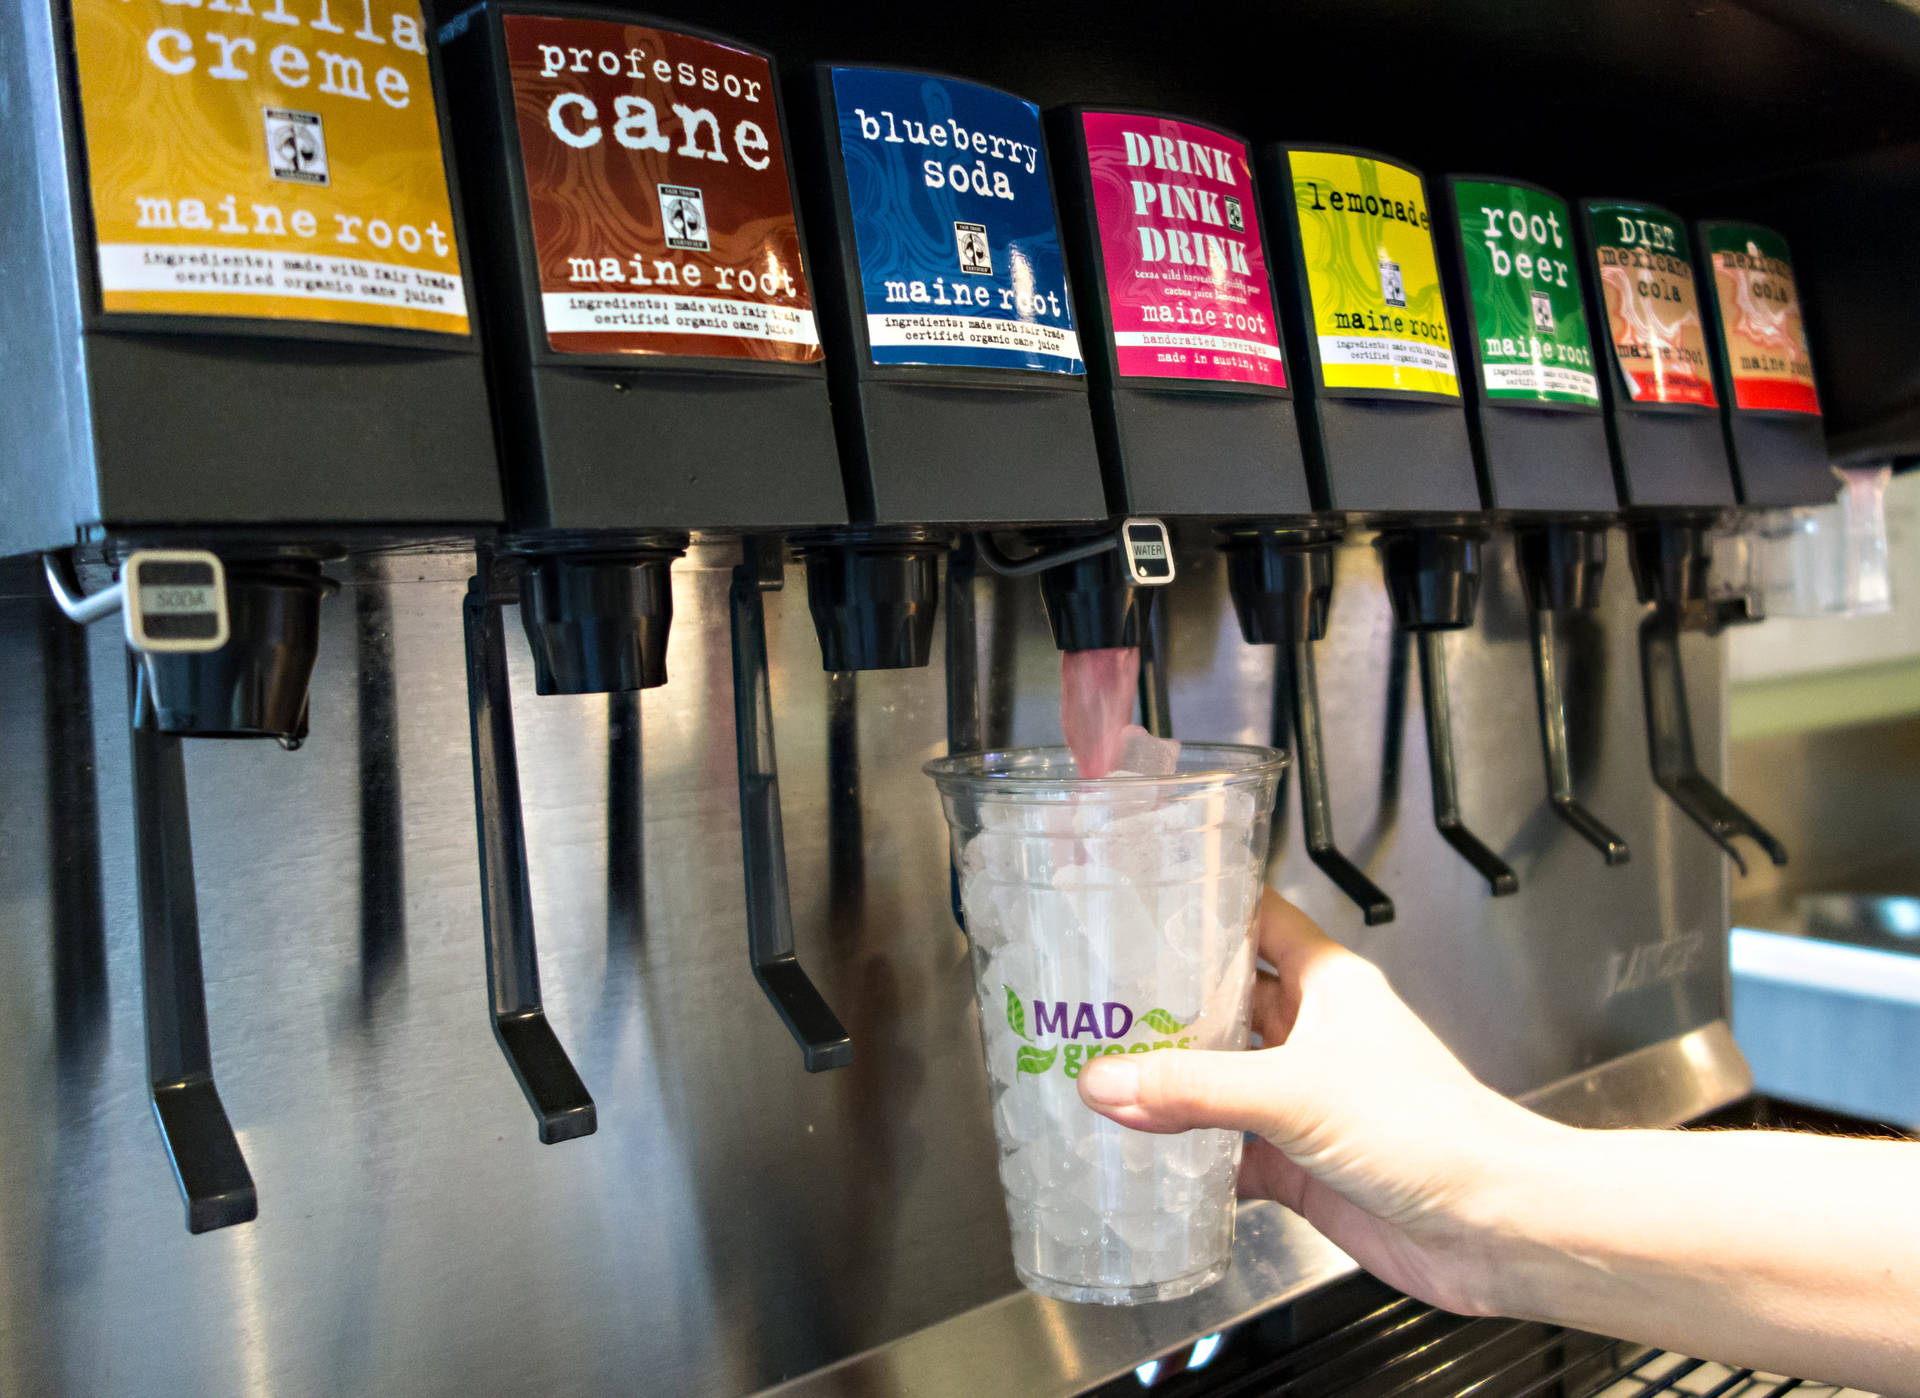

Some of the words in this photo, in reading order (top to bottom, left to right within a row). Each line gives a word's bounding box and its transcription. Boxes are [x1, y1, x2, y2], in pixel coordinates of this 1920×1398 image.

[147, 28, 410, 109] creme
[538, 43, 761, 103] professor
[547, 92, 771, 171] cane
[855, 108, 1037, 174] blueberry
[1122, 131, 1236, 186] DRINK
[923, 159, 1015, 201] soda
[1130, 180, 1224, 227] PINK
[1307, 182, 1429, 231] lemonade
[136, 194, 318, 238] maine
[334, 212, 449, 257] root
[1481, 206, 1563, 249] root
[1617, 216, 1676, 252] DIET
[1137, 227, 1251, 277] DRINK
[1485, 240, 1568, 288] beer
[568, 254, 701, 287] maine
[714, 264, 797, 298] root
[884, 277, 990, 306] maine
[1638, 278, 1682, 302] cola
[1752, 280, 1788, 303] cola
[570, 298, 667, 311] ingredients:
[675, 301, 704, 312] made
[708, 302, 738, 315] with
[742, 306, 767, 318] fair
[594, 313, 669, 325] certified
[676, 316, 728, 329] organic
[733, 320, 760, 331] cane
[1141, 302, 1216, 326] maine
[1223, 311, 1266, 335] root
[885, 317, 963, 329] ingredients:
[968, 320, 992, 330] made
[995, 322, 1017, 333] with
[1043, 328, 1065, 341] trade
[905, 330, 965, 341] certified
[969, 334, 1010, 345] organic
[1038, 339, 1060, 351] juice
[1142, 334, 1216, 347] handcrafted
[1334, 310, 1403, 333] maine
[1409, 318, 1446, 342] root
[1157, 352, 1187, 363] made
[1194, 352, 1207, 364] in
[1556, 343, 1590, 367] root
[1617, 342, 1672, 360] maie
[1134, 544, 1162, 556] WATER
[157, 590, 205, 607] SODA
[1033, 1000, 1133, 1040] MAD
